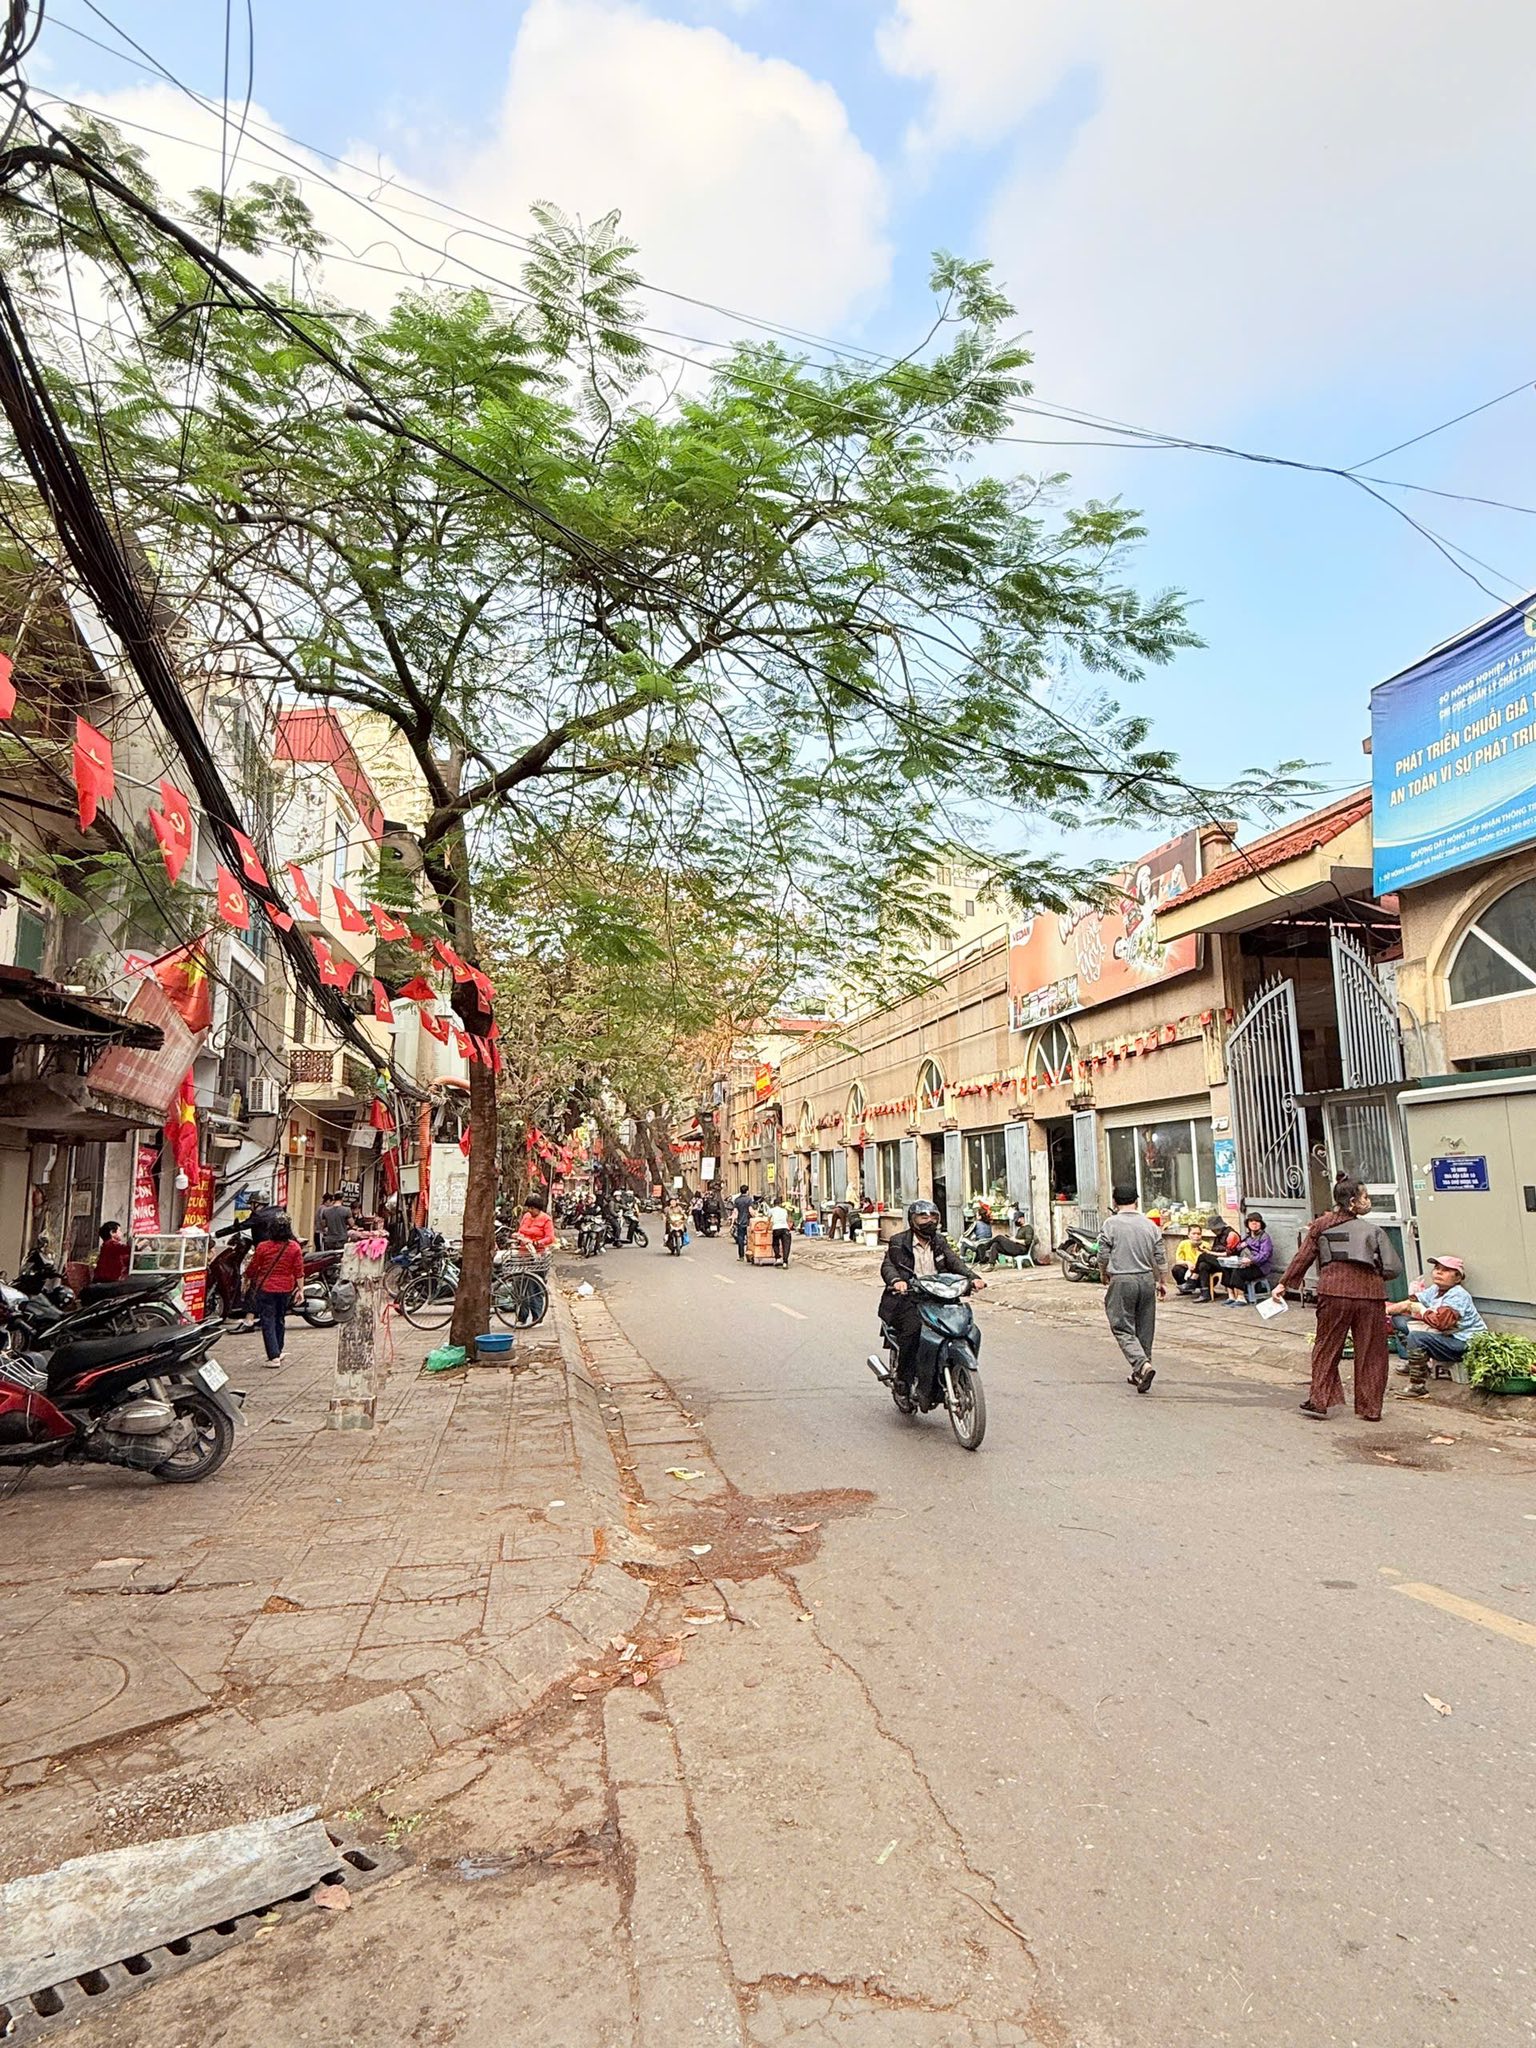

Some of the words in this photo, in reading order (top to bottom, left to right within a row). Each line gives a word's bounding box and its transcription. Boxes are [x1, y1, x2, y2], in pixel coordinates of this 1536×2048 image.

[1395, 748, 1424, 778] PHÁT
[1426, 728, 1460, 762] TRIỂN
[1505, 692, 1529, 723] GIÁ
[1389, 786, 1406, 808] AN
[1408, 771, 1438, 799] TOÀN
[1440, 760, 1452, 784] VÌ
[1455, 751, 1474, 777] SỰ
[1474, 736, 1508, 768] PHÁT
[183, 1210, 207, 1225] NÓNG
